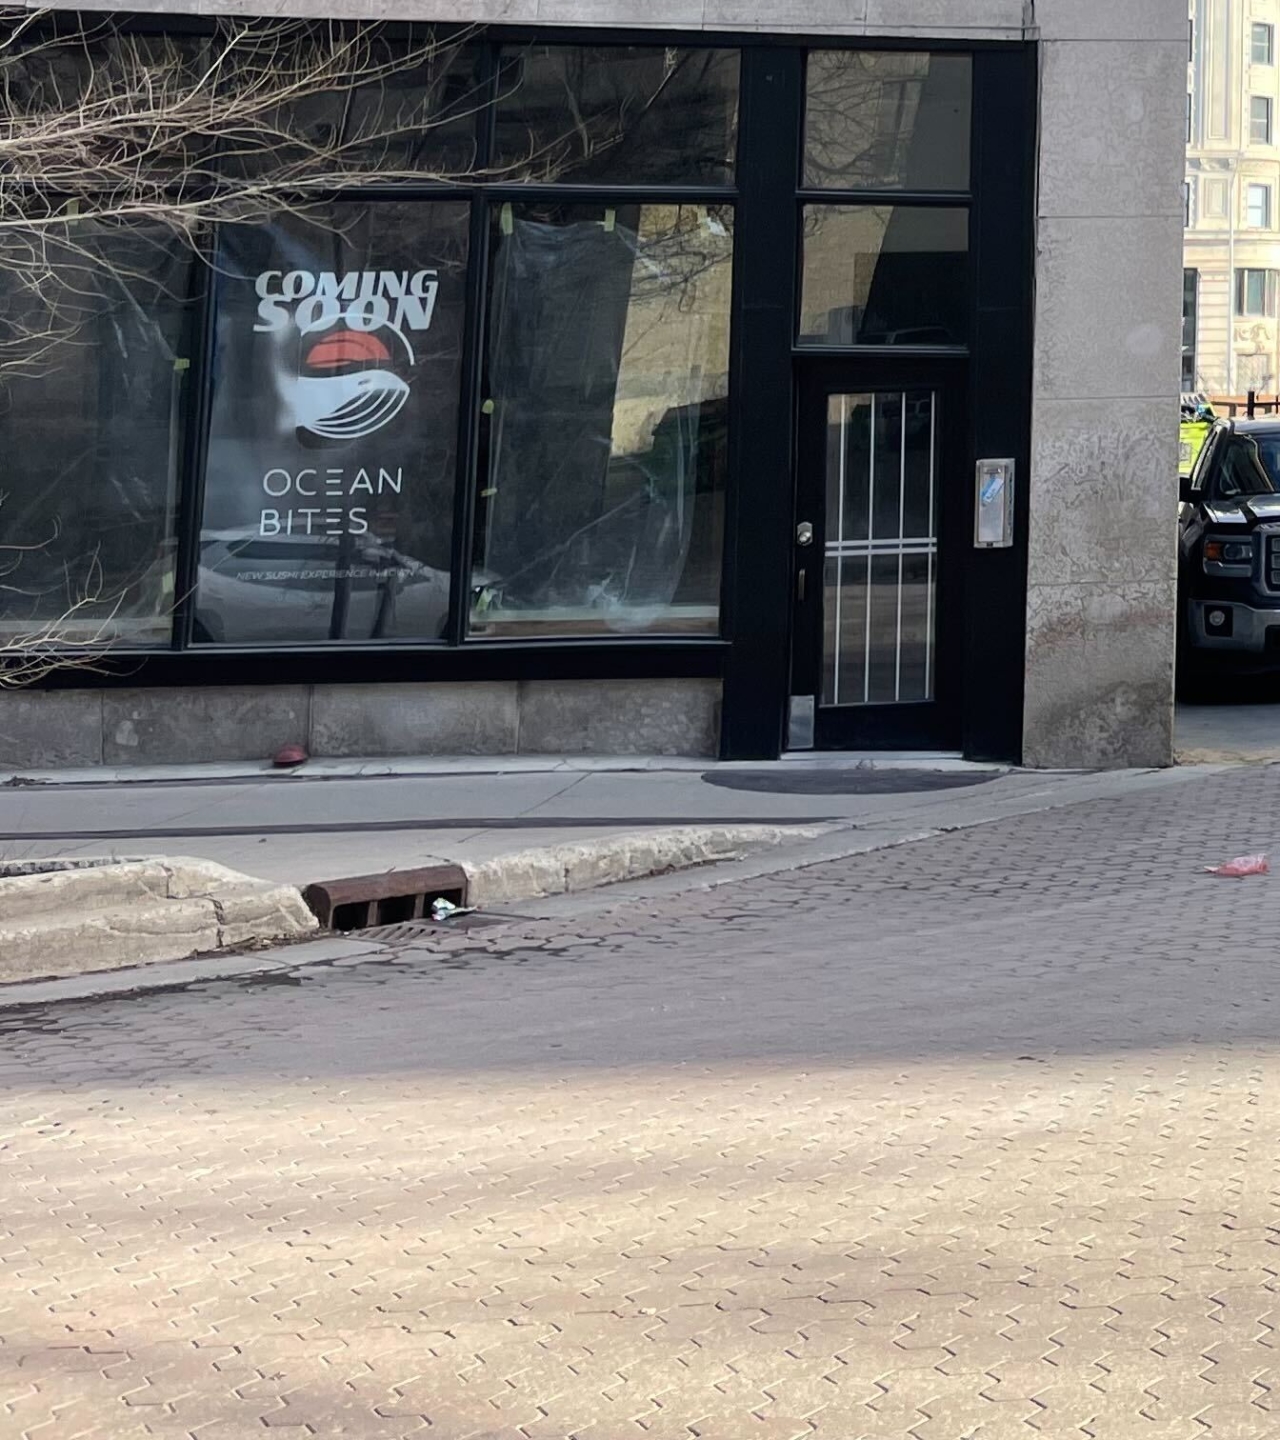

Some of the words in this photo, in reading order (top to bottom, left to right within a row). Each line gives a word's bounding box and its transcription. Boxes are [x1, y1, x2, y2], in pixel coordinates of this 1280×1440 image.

[254, 270, 439, 299] COMING
[253, 295, 437, 332] SOON
[263, 467, 402, 496] OCEAN
[259, 507, 368, 537] BITES
[236, 571, 262, 580] NEW
[264, 570, 299, 580] SUSHI
